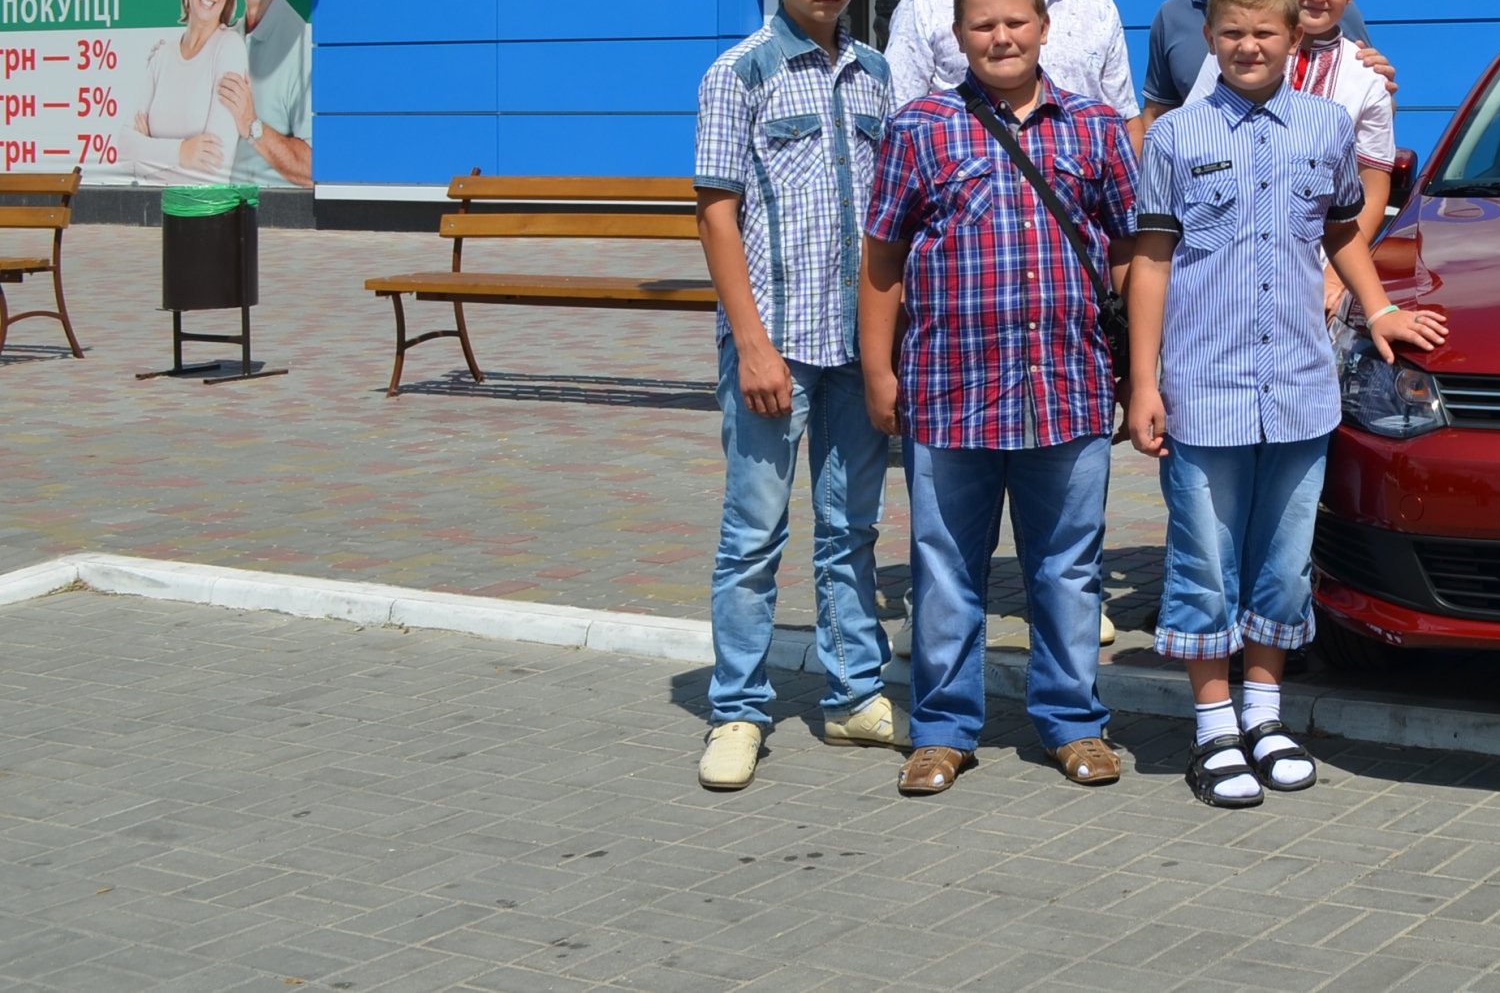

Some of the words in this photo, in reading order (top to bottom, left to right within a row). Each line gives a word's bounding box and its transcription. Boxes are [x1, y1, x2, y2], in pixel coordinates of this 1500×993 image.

[0, 48, 36, 80] рн
[77, 39, 118, 70] 3%
[0, 95, 36, 126] рн
[77, 86, 118, 117] 5%
[0, 141, 36, 171] рн
[77, 134, 118, 165] 7%
